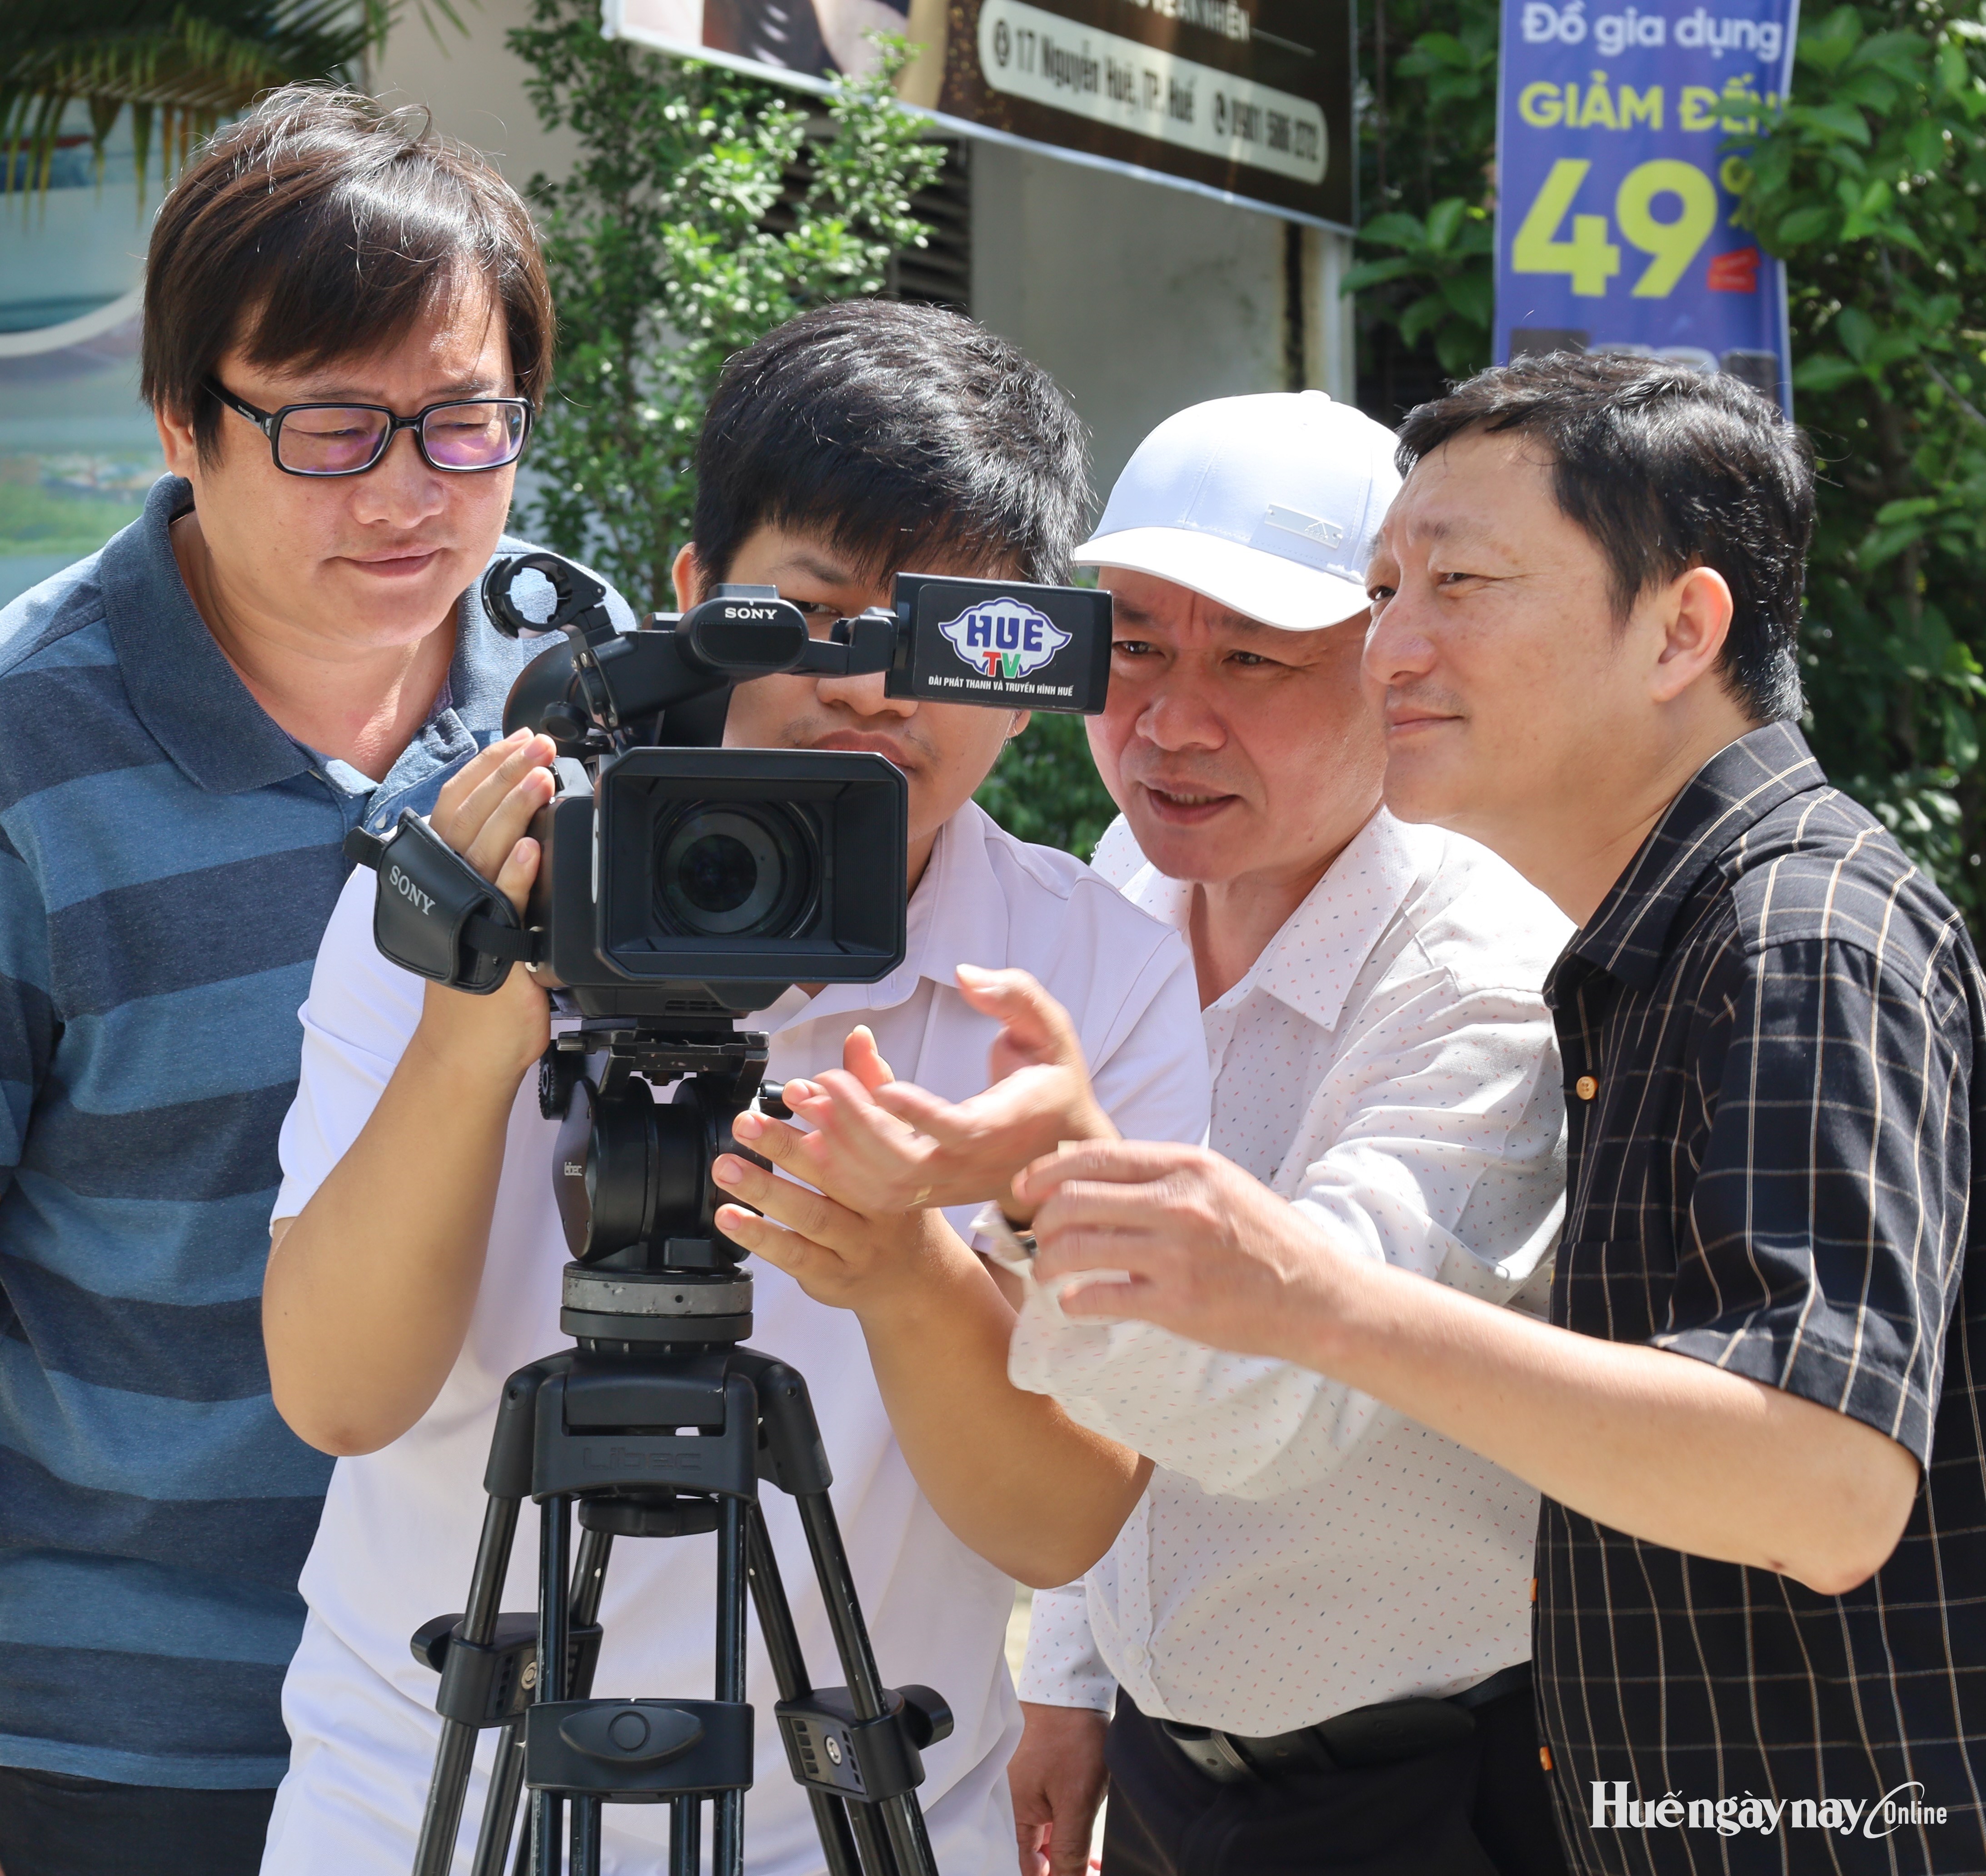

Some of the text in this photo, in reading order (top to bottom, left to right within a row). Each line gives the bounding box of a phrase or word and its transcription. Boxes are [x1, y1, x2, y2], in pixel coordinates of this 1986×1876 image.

[1016, 26, 1037, 74] 17
[1594, 5, 1666, 57] gia
[1674, 6, 1782, 63] dụng
[1518, 70, 1664, 131] GIẢM
[725, 607, 778, 620] SONY
[966, 615, 1044, 652] HUE
[982, 651, 1022, 679] TV
[928, 676, 942, 686] ĐÀI
[943, 677, 964, 687] PHÁT
[966, 679, 992, 690] THANH
[993, 680, 1003, 691] VÀ
[1036, 683, 1056, 695] HÌNH
[1057, 685, 1074, 697] HUẾ
[389, 865, 436, 916] SONY
